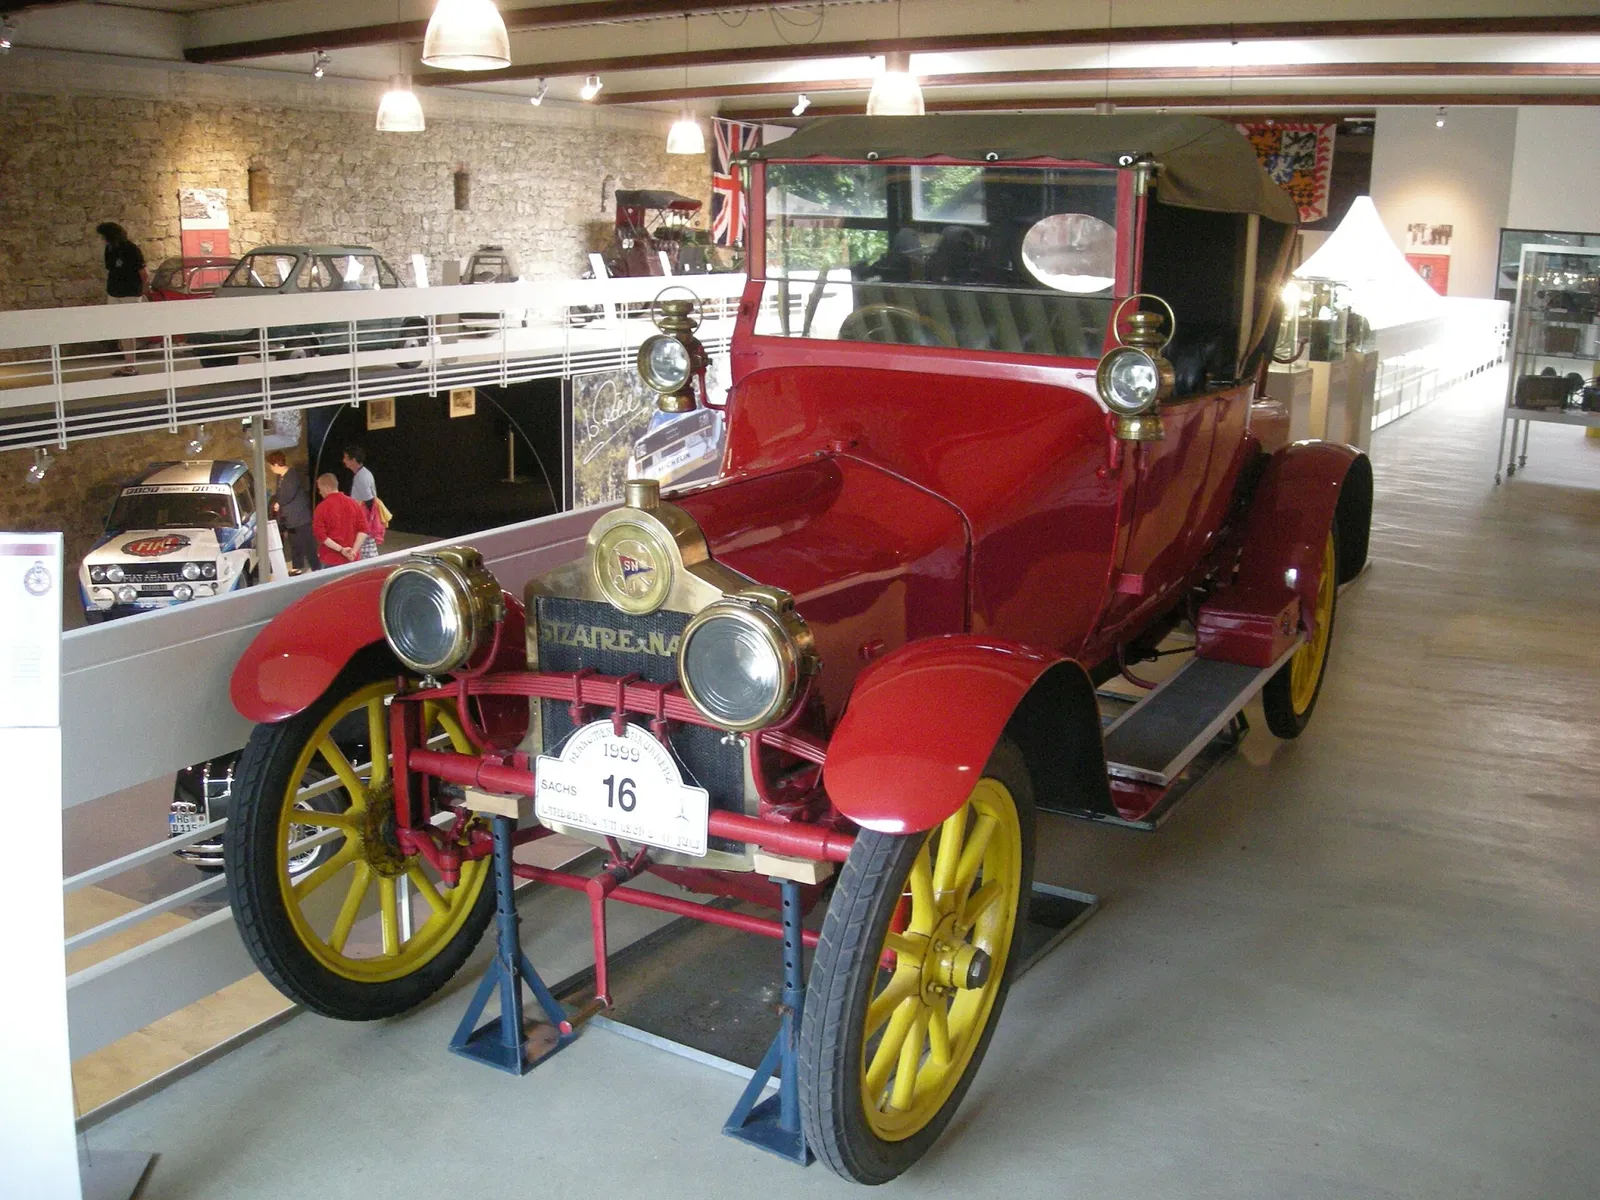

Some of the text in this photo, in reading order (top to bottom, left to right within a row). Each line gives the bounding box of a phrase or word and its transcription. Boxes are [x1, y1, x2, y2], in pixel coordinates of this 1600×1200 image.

[657, 452, 692, 473] MICHELIN
[623, 560, 639, 572] SN
[123, 572, 185, 583] FIAT ABARTH
[604, 743, 640, 763] 1999
[541, 779, 577, 796] SACHS
[602, 774, 637, 812] 16
[176, 815, 189, 824] HG
